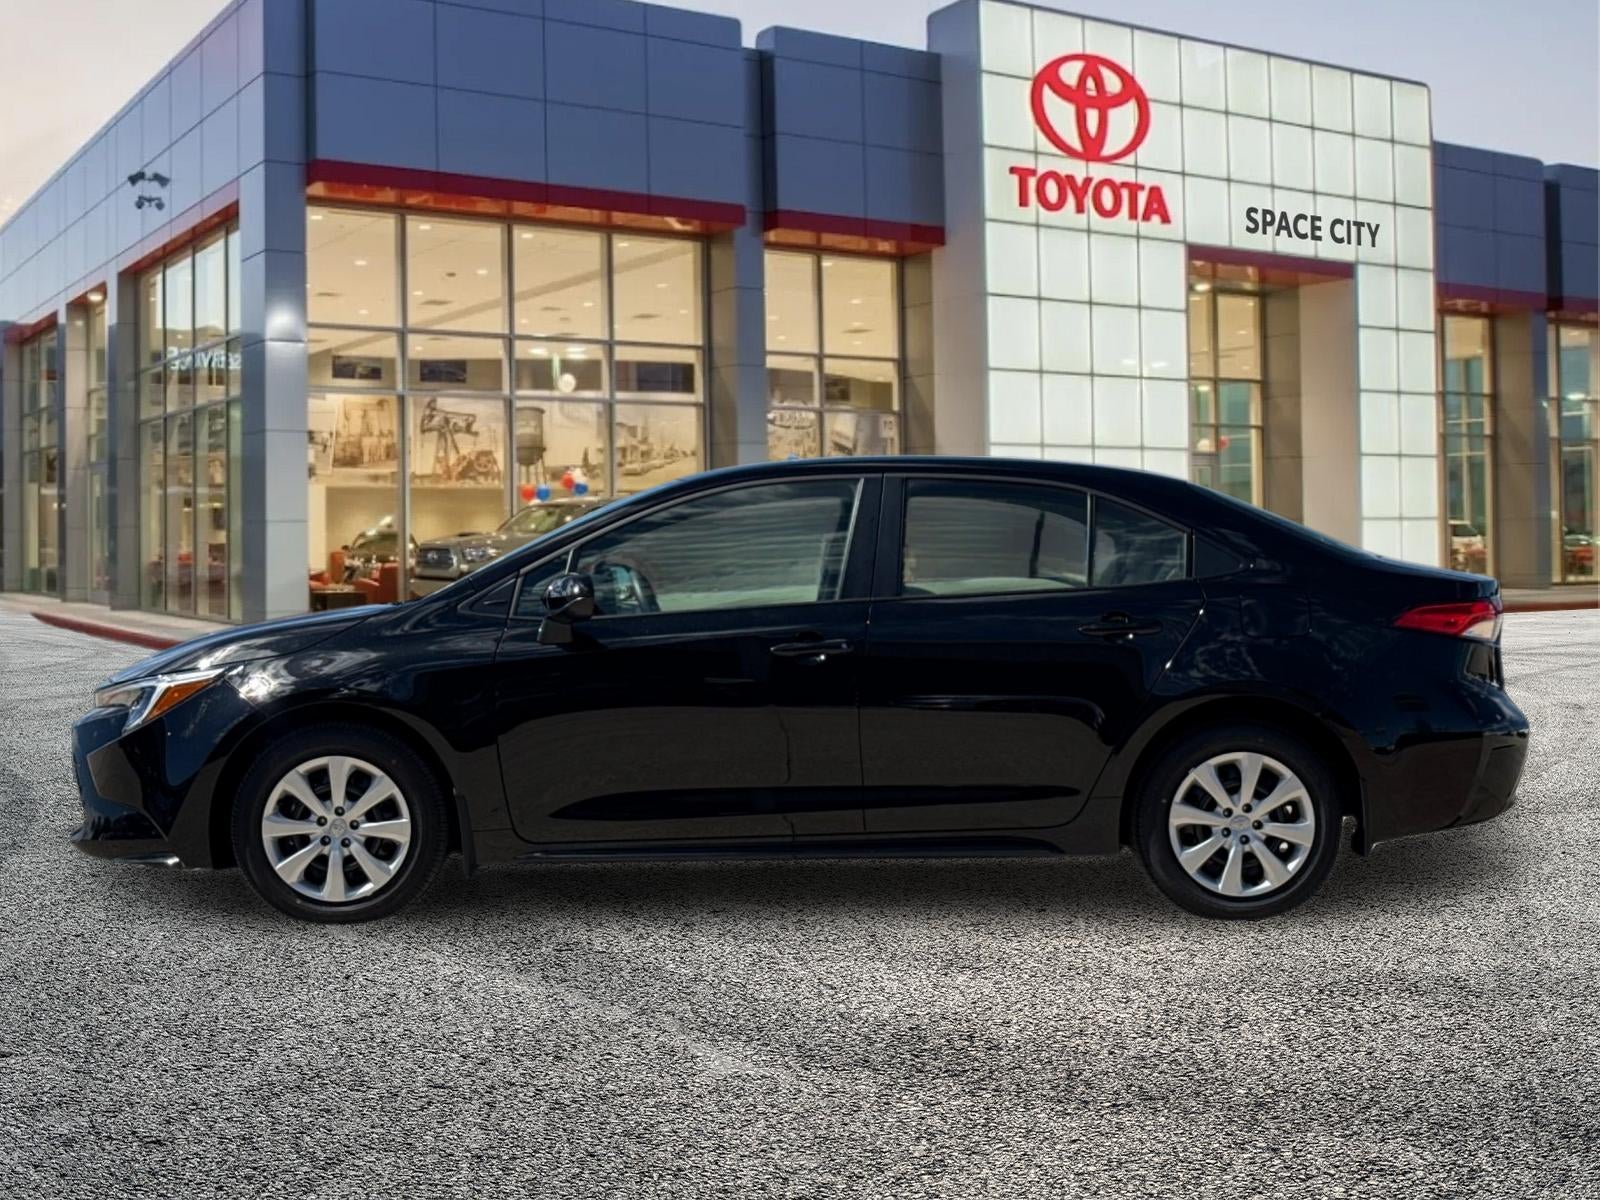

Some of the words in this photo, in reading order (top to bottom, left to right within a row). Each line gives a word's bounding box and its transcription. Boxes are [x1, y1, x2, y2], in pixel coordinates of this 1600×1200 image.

[1009, 166, 1171, 224] TOYOTA
[1245, 206, 1323, 241] SPACE
[1329, 218, 1381, 248] CITY
